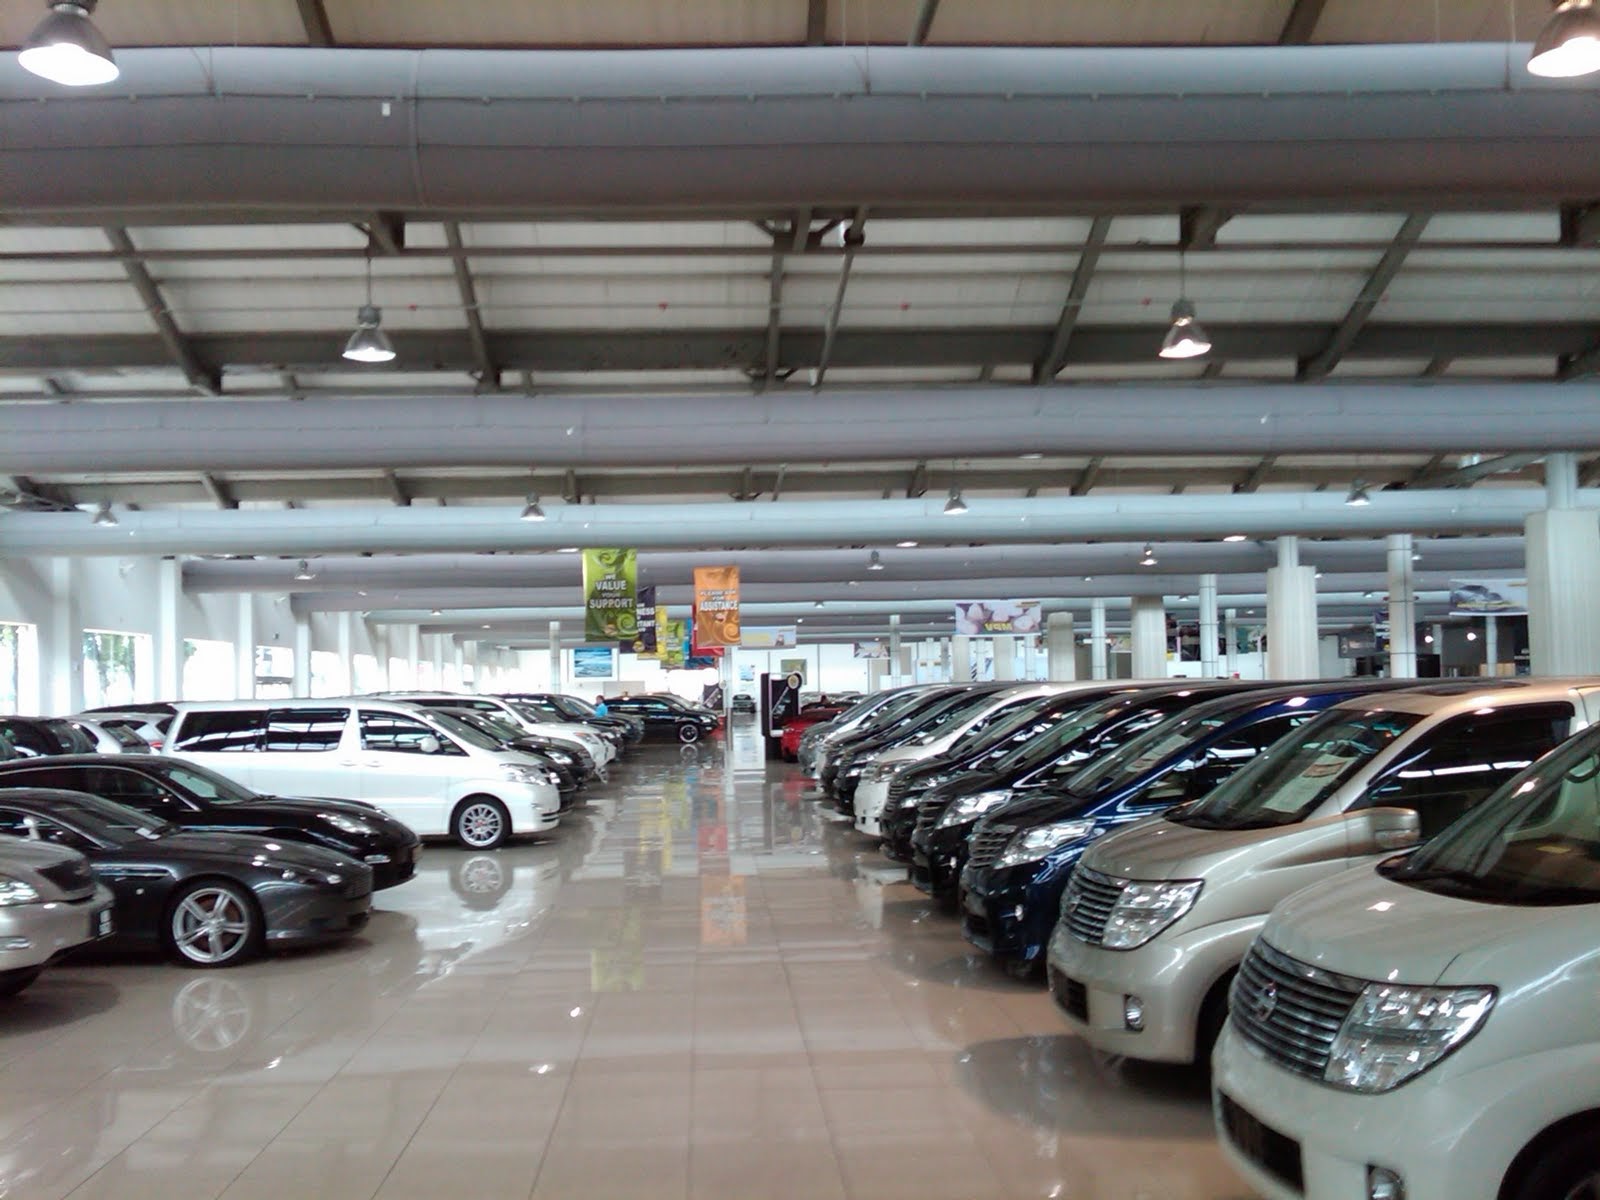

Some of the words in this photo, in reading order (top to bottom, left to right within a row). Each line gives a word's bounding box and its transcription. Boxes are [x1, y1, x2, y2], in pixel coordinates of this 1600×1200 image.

[595, 580, 627, 590] VALUE
[589, 598, 634, 609] SUPPORT
[700, 600, 738, 611] ASSISTANCE
